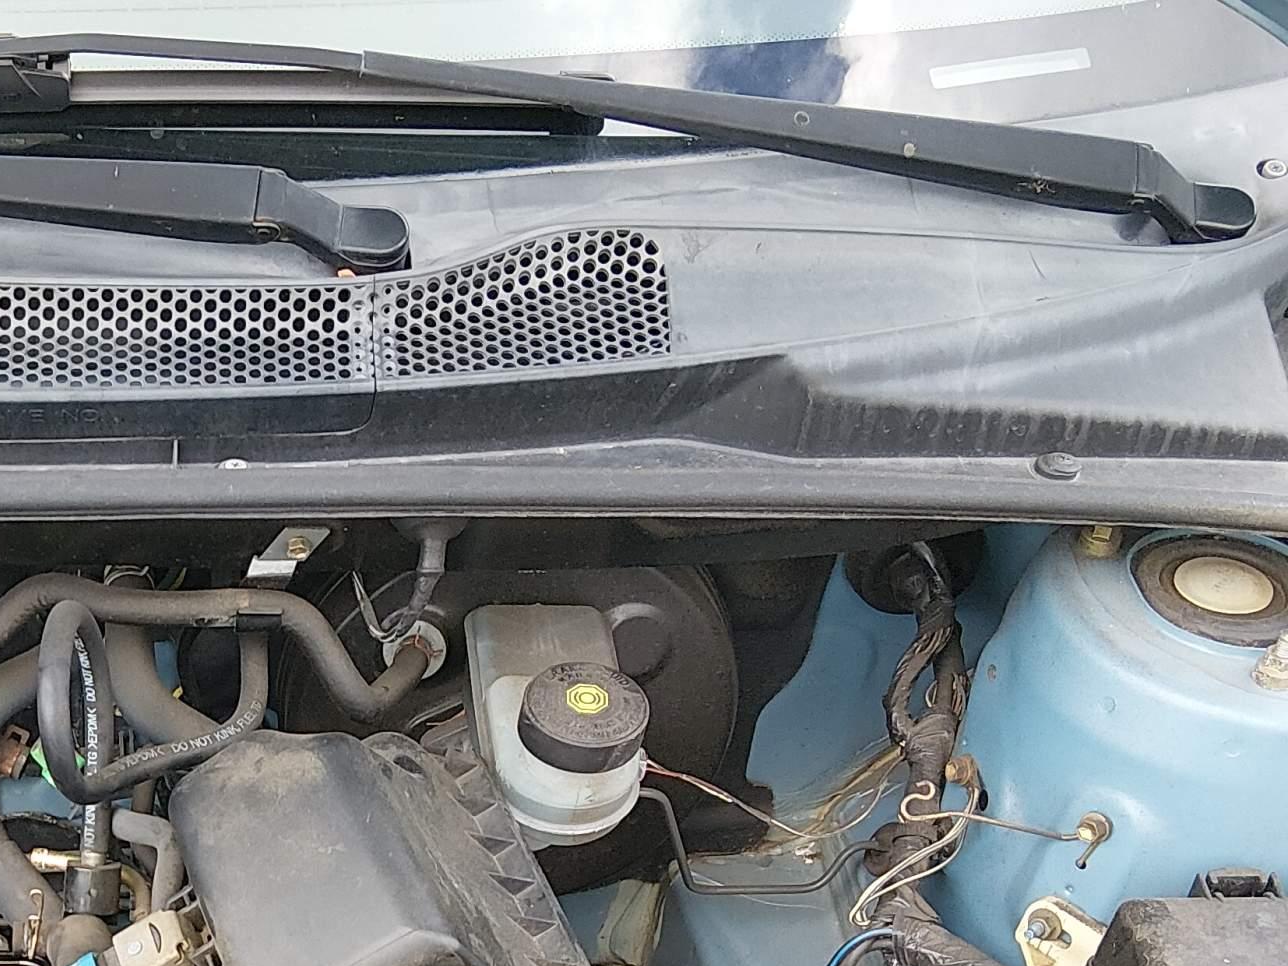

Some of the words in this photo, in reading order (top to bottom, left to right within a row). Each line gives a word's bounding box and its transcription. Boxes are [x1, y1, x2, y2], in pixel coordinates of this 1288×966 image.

[171, 742, 189, 753] DO
[190, 735, 214, 749] NOT
[85, 805, 97, 825] KIN
